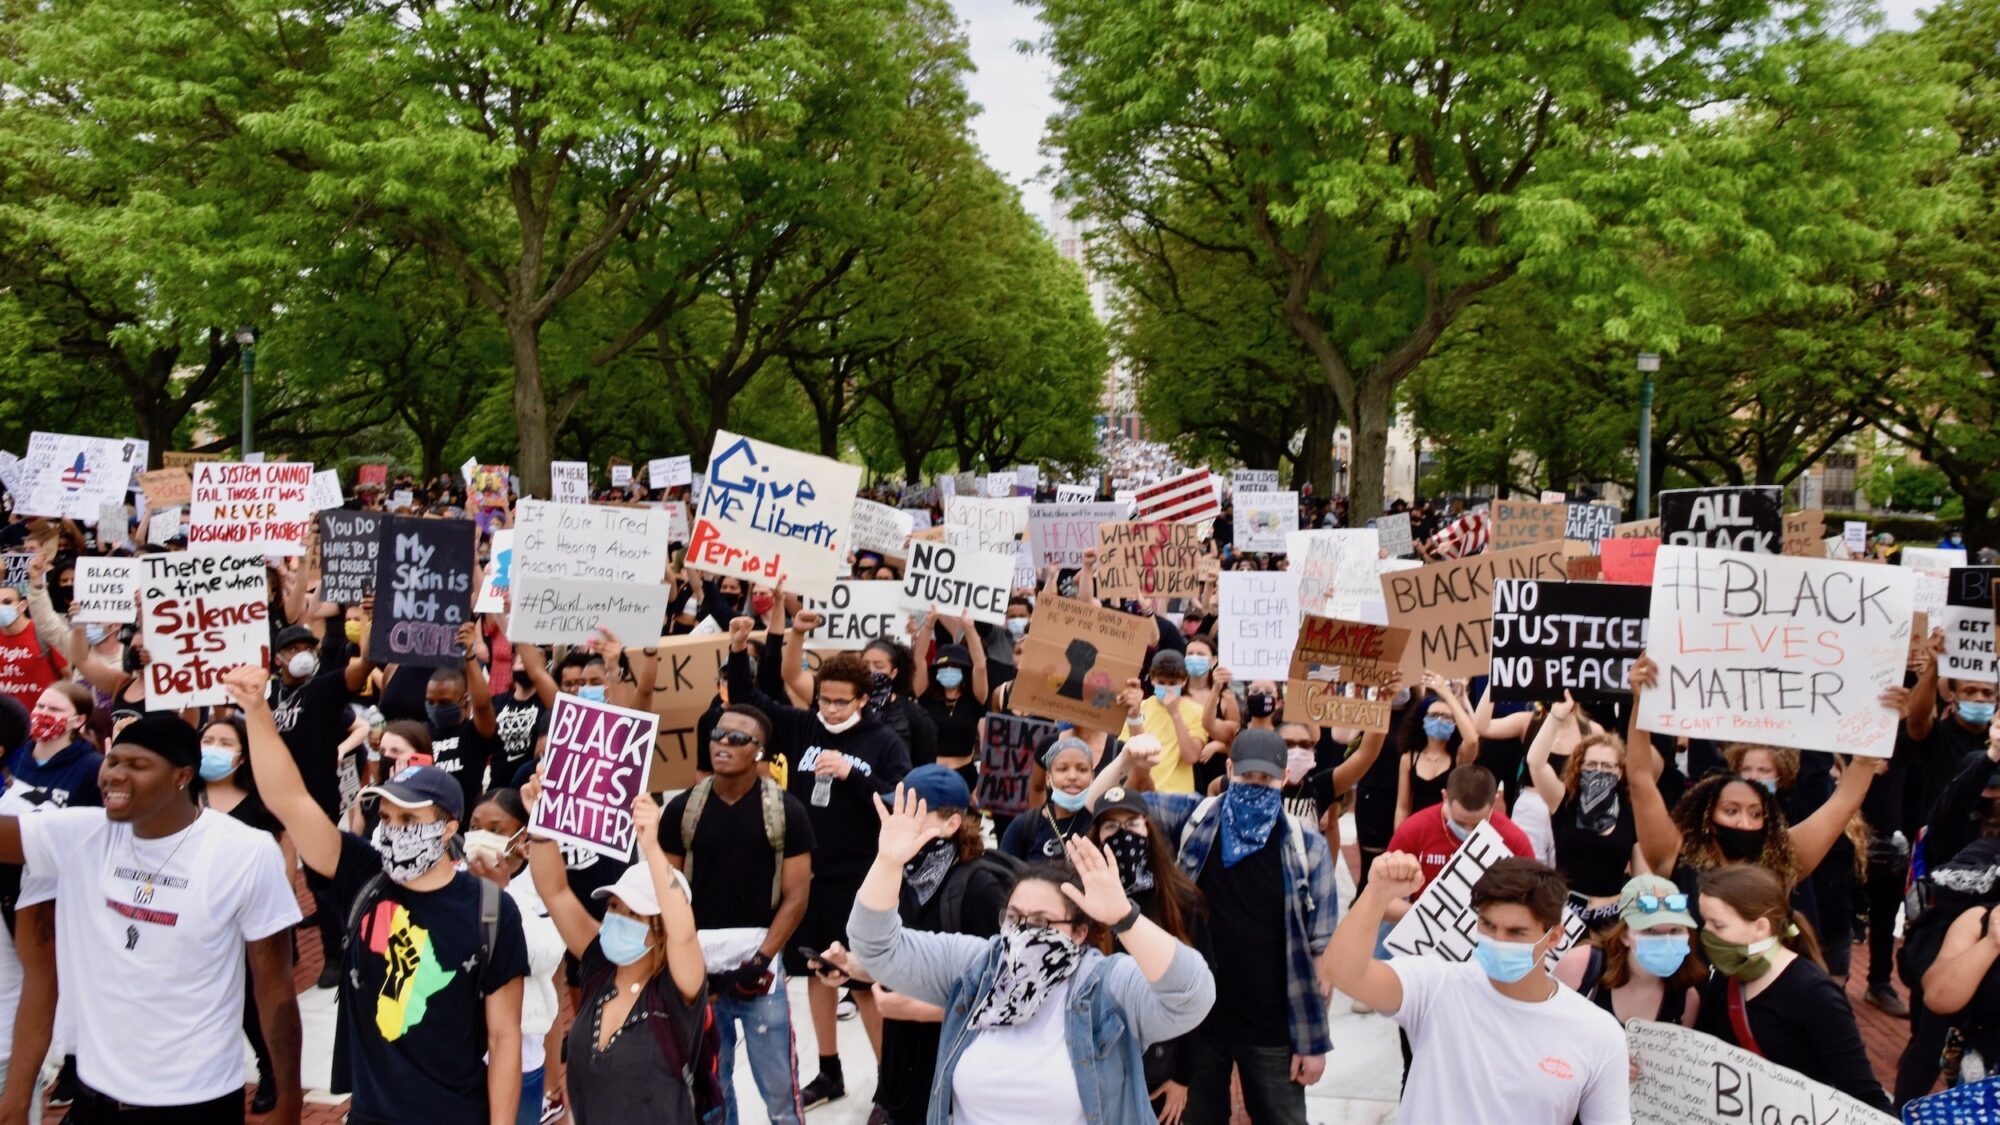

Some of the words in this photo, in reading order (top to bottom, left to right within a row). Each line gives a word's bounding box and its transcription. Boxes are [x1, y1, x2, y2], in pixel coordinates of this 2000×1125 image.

[199, 466, 213, 484] A
[219, 465, 261, 484] SYSTEM
[266, 465, 312, 485] CANNOT
[711, 438, 816, 507] Give
[197, 488, 222, 502] FAIL
[227, 487, 260, 501] THOSE
[262, 486, 276, 499] IT
[278, 487, 305, 502] WAS
[561, 481, 575, 493] TO
[214, 503, 278, 520] NEVER
[522, 506, 545, 522] If
[601, 509, 649, 536] Tired
[945, 496, 1015, 535] Racism
[1497, 504, 1557, 521] BLACK
[1567, 504, 1614, 523] EPEAL
[1688, 494, 1754, 530] ALL
[190, 523, 246, 543] DESIGNED
[264, 521, 309, 541] PROTECT
[355, 517, 374, 535] DO
[1101, 523, 1148, 545] WHAT
[1155, 523, 1197, 548] SIDE
[1496, 524, 1555, 537] LIVES
[323, 542, 350, 558] HAVE
[351, 541, 365, 557] TO
[395, 532, 435, 567] My
[524, 529, 545, 550] Of
[557, 533, 598, 560] Hearing
[605, 540, 651, 560] About
[1099, 547, 1116, 564] OF
[1124, 545, 1198, 570] HISTORY
[142, 557, 216, 579] There
[220, 553, 265, 572] comes
[328, 560, 339, 572] IN
[340, 559, 371, 573] ORDER
[520, 555, 568, 576] Racism
[573, 560, 636, 583] Imagine
[912, 543, 956, 574] NO
[87, 567, 130, 578] BLACK
[324, 575, 336, 588] TO
[448, 569, 469, 591] is
[1098, 567, 1132, 588] WILL
[1136, 568, 1165, 593] YOU
[1168, 571, 1183, 593] BE
[1184, 573, 1199, 591] ON
[1242, 577, 1276, 593] TU
[1391, 562, 1489, 614] BLACK
[1491, 551, 1568, 581] LIVES
[89, 584, 124, 594] LIVES
[146, 587, 165, 599] a
[175, 576, 222, 598] time
[225, 573, 264, 590] when
[327, 588, 350, 603] EACH
[1494, 580, 1539, 612] NO
[1662, 551, 1893, 627] #BLACK
[80, 600, 131, 611] MATTER
[393, 591, 439, 621] Not
[444, 605, 462, 621] a
[520, 589, 650, 615] #BlackLivesMatter
[1231, 594, 1290, 616] LUCHA
[152, 597, 268, 634] Silence
[534, 616, 600, 633] #FUCK12
[1959, 619, 1991, 633] GET
[389, 620, 466, 657] CRIME
[1265, 620, 1282, 638] MI
[1304, 617, 1387, 657] HATE
[1493, 613, 1650, 649] JUSTICE!
[174, 631, 226, 655] IS
[1231, 640, 1289, 666] LUCHA
[1421, 618, 1493, 668] MAT
[1677, 619, 1846, 667] LIVES
[1959, 638, 1993, 653] KNE
[1492, 656, 1534, 688] NO
[1545, 656, 1637, 689] PEACE
[1949, 656, 1983, 672] OUR
[1322, 679, 1388, 702] AMERICA
[1670, 663, 1843, 716] MATTER
[1306, 684, 1391, 727] GREAT
[552, 700, 652, 766] BLACK
[1659, 715, 1674, 727] I
[985, 747, 1030, 772] LIV
[540, 747, 633, 807] LIVES
[980, 773, 1030, 802] MATT
[538, 789, 633, 849] MATTER
[1426, 853, 1446, 865] am
[1388, 832, 1491, 957] WHITE
[1627, 1019, 1679, 1045] George
[1681, 1030, 1718, 1053] Floyd
[1711, 1061, 1839, 1125] Black
